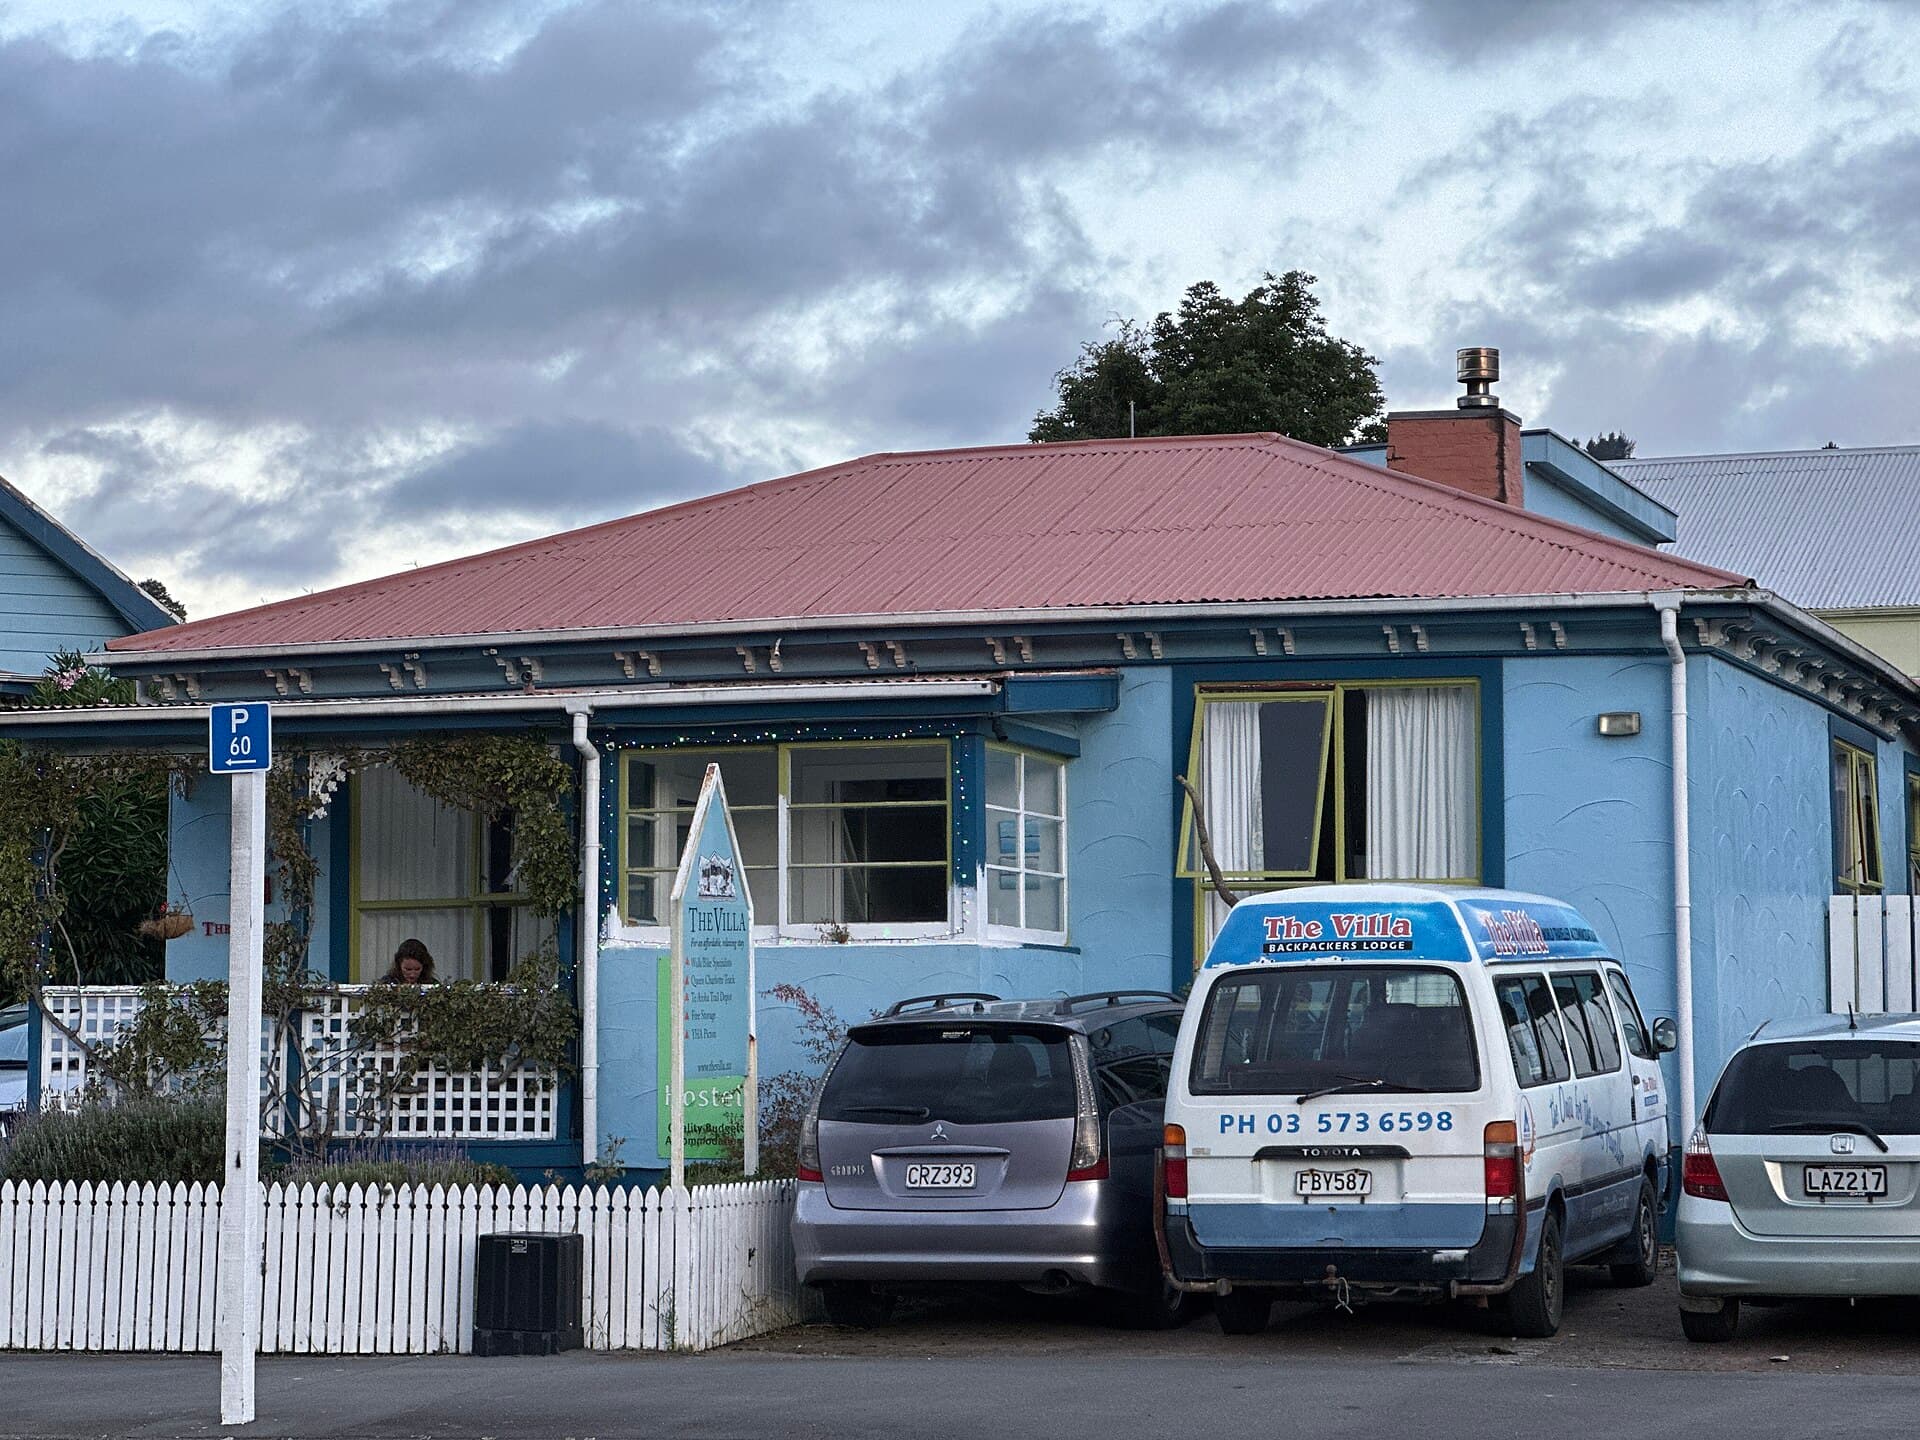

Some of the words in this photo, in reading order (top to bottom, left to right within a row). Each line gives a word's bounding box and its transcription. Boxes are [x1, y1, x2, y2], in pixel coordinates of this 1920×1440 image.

[232, 709, 249, 733] P
[230, 736, 251, 755] 60
[1264, 915, 1323, 940] The
[1330, 913, 1412, 938] Villa
[1501, 909, 1549, 954] Villa
[1269, 942, 1357, 953] BACKPACKERS
[1363, 941, 1405, 950] LODGE
[1219, 1114, 1256, 1134] PH
[1267, 1113, 1300, 1134] 03
[1317, 1112, 1370, 1133] 573
[1378, 1111, 1454, 1132] 6598
[1302, 1148, 1361, 1157] TOYOTA
[830, 1164, 865, 1176] GRANDIS
[908, 1166, 973, 1185] CRZ393
[1299, 1173, 1369, 1191] FBY587
[1808, 1171, 1882, 1190] LAZ217
